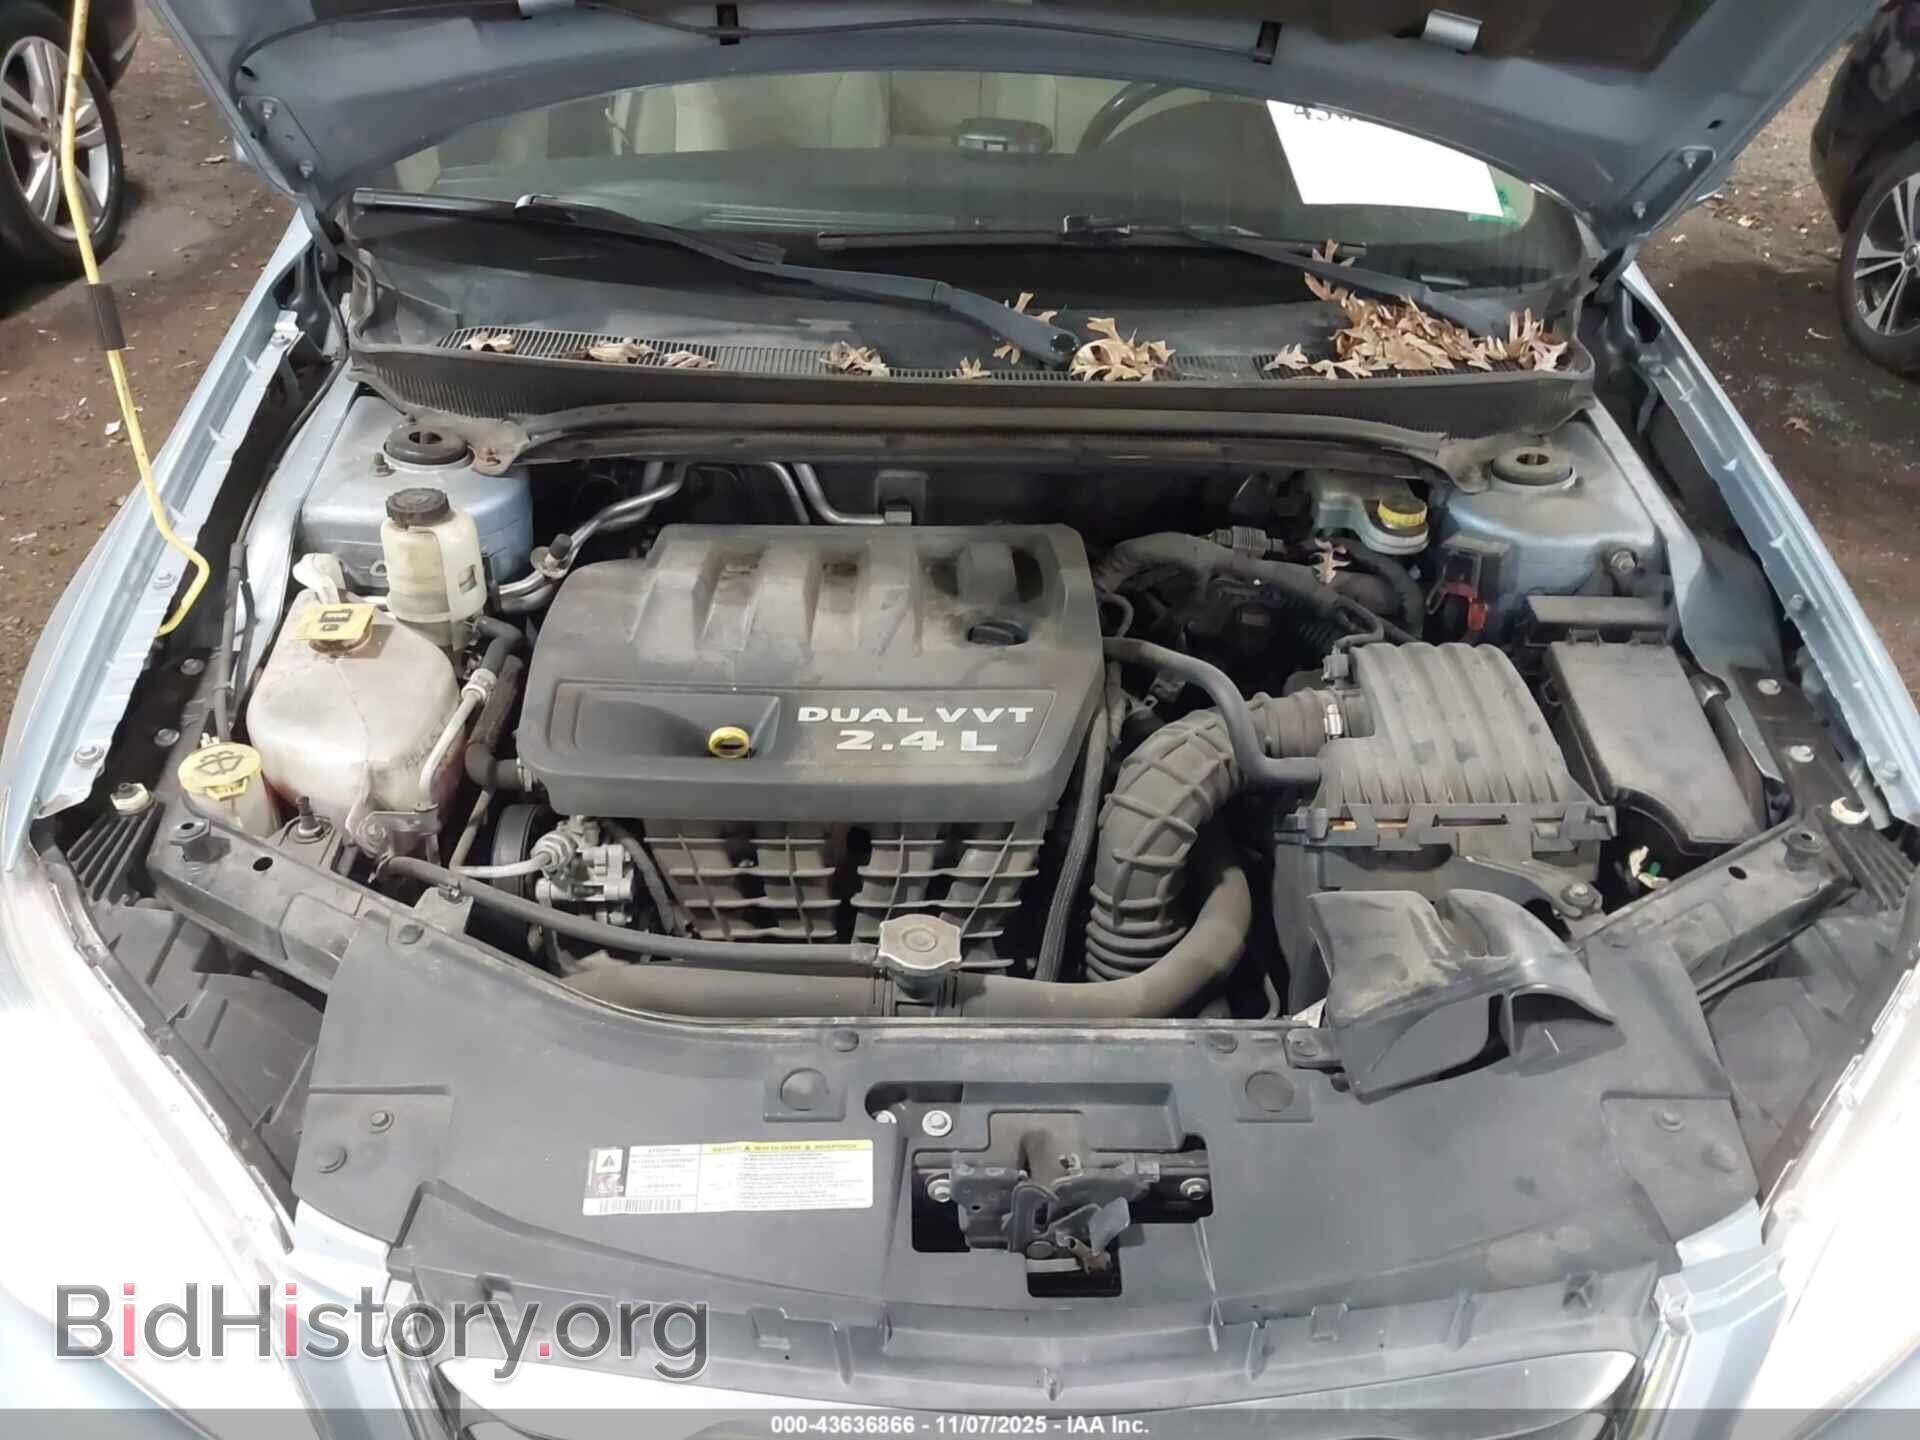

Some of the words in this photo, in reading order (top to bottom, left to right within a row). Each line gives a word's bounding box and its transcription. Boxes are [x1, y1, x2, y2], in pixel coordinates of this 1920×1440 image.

[797, 706, 925, 723] DUAL
[935, 707, 1034, 723] VVT
[836, 729, 945, 751] 2.4
